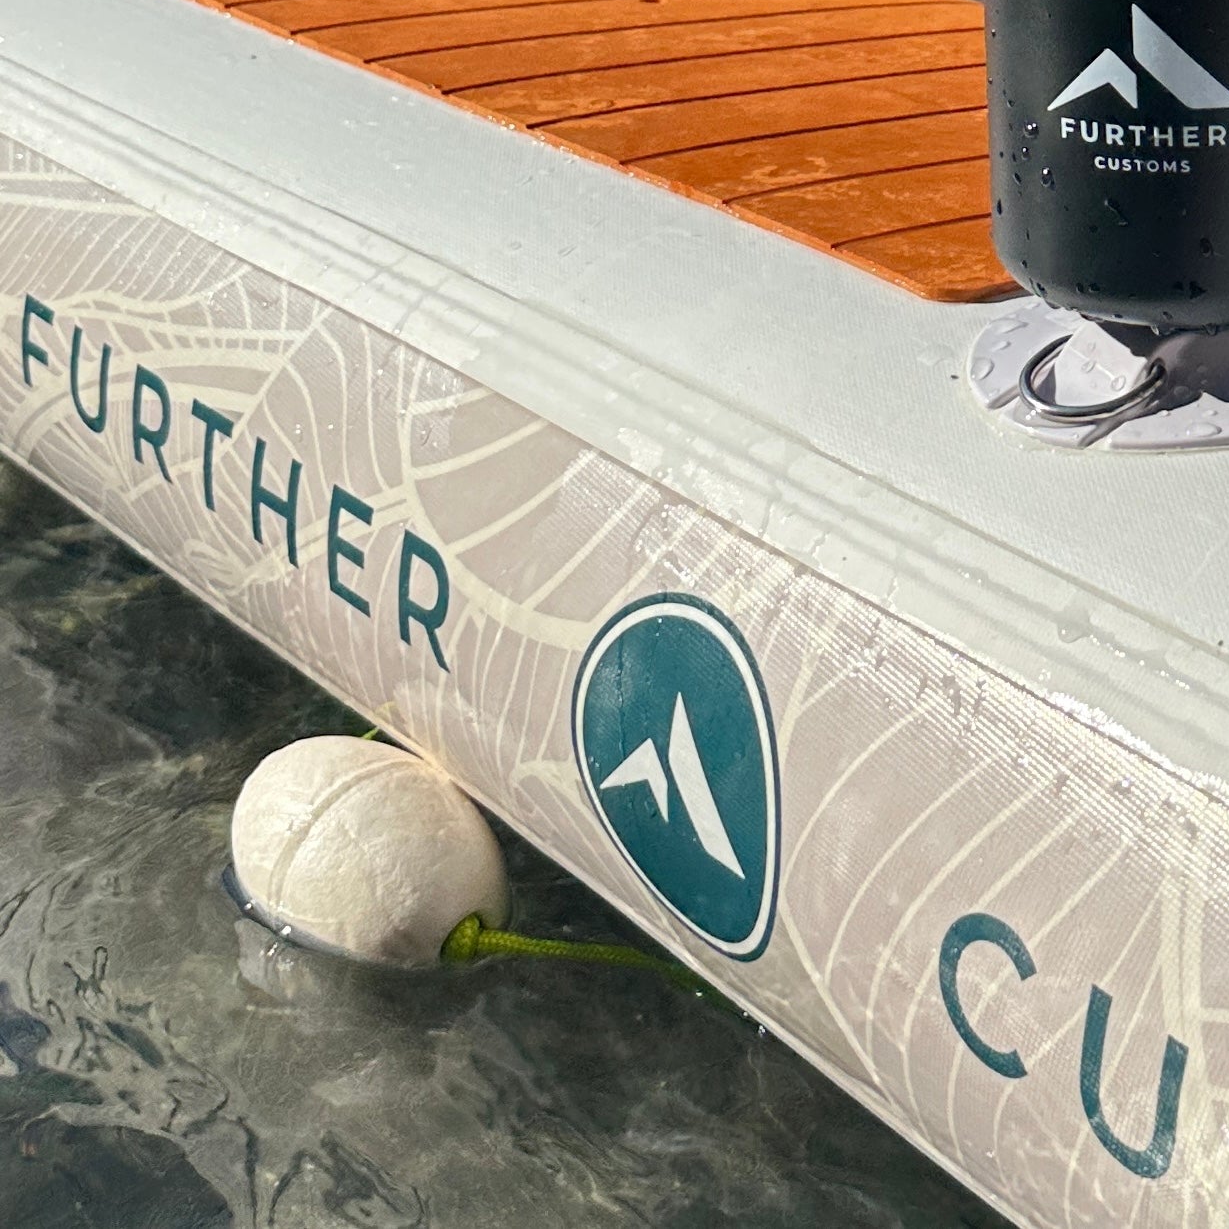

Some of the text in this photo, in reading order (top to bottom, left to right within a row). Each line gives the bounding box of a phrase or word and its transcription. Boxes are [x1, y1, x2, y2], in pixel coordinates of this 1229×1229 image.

[1060, 117, 1227, 147] FURTHER
[1094, 156, 1191, 173] CUSTOMS
[21, 294, 450, 673] FURTHER
